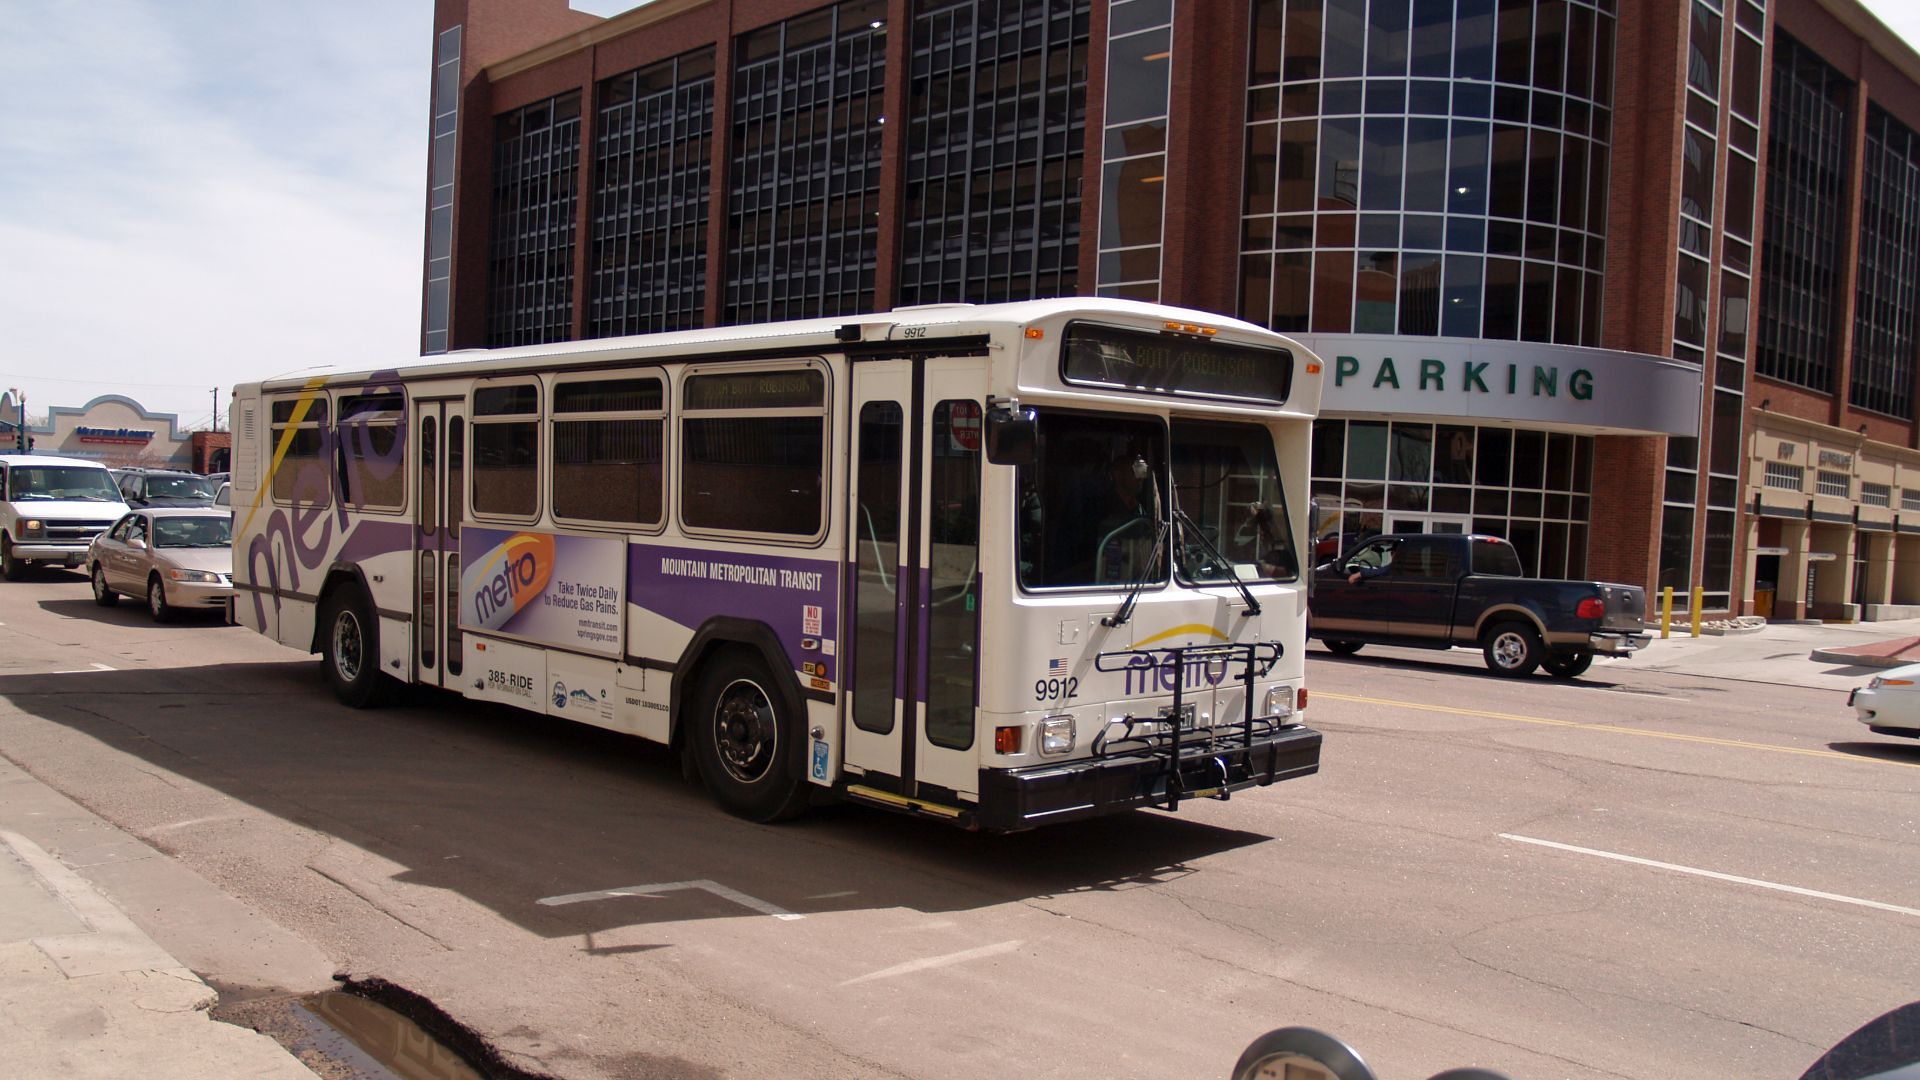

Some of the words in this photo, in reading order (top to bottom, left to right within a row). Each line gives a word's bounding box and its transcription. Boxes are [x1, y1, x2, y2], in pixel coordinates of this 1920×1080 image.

[903, 327, 927, 338] 9912
[1182, 351, 1257, 378] ROBINSON
[759, 379, 810, 394] ROBINSON
[1334, 356, 1594, 400] PARKING
[249, 368, 406, 634] metro
[661, 557, 707, 579] MOUNTAIN
[709, 562, 777, 587] METROPOLITAN
[780, 569, 822, 592] TRANSIT
[475, 552, 536, 624] metro
[558, 581, 575, 596] Take
[576, 583, 598, 598] Twice
[598, 586, 618, 603] Daily
[544, 594, 552, 606] to
[552, 596, 579, 610] Reduce
[579, 598, 594, 612] Gas
[595, 600, 619, 615] Pains.
[807, 606, 818, 619] NO
[577, 630, 618, 643] springsgov.com
[578, 619, 618, 632] mmtransit.com
[488, 670, 533, 690] 385-RIDE
[1125, 642, 1228, 696] metro
[1035, 676, 1078, 701] 9912
